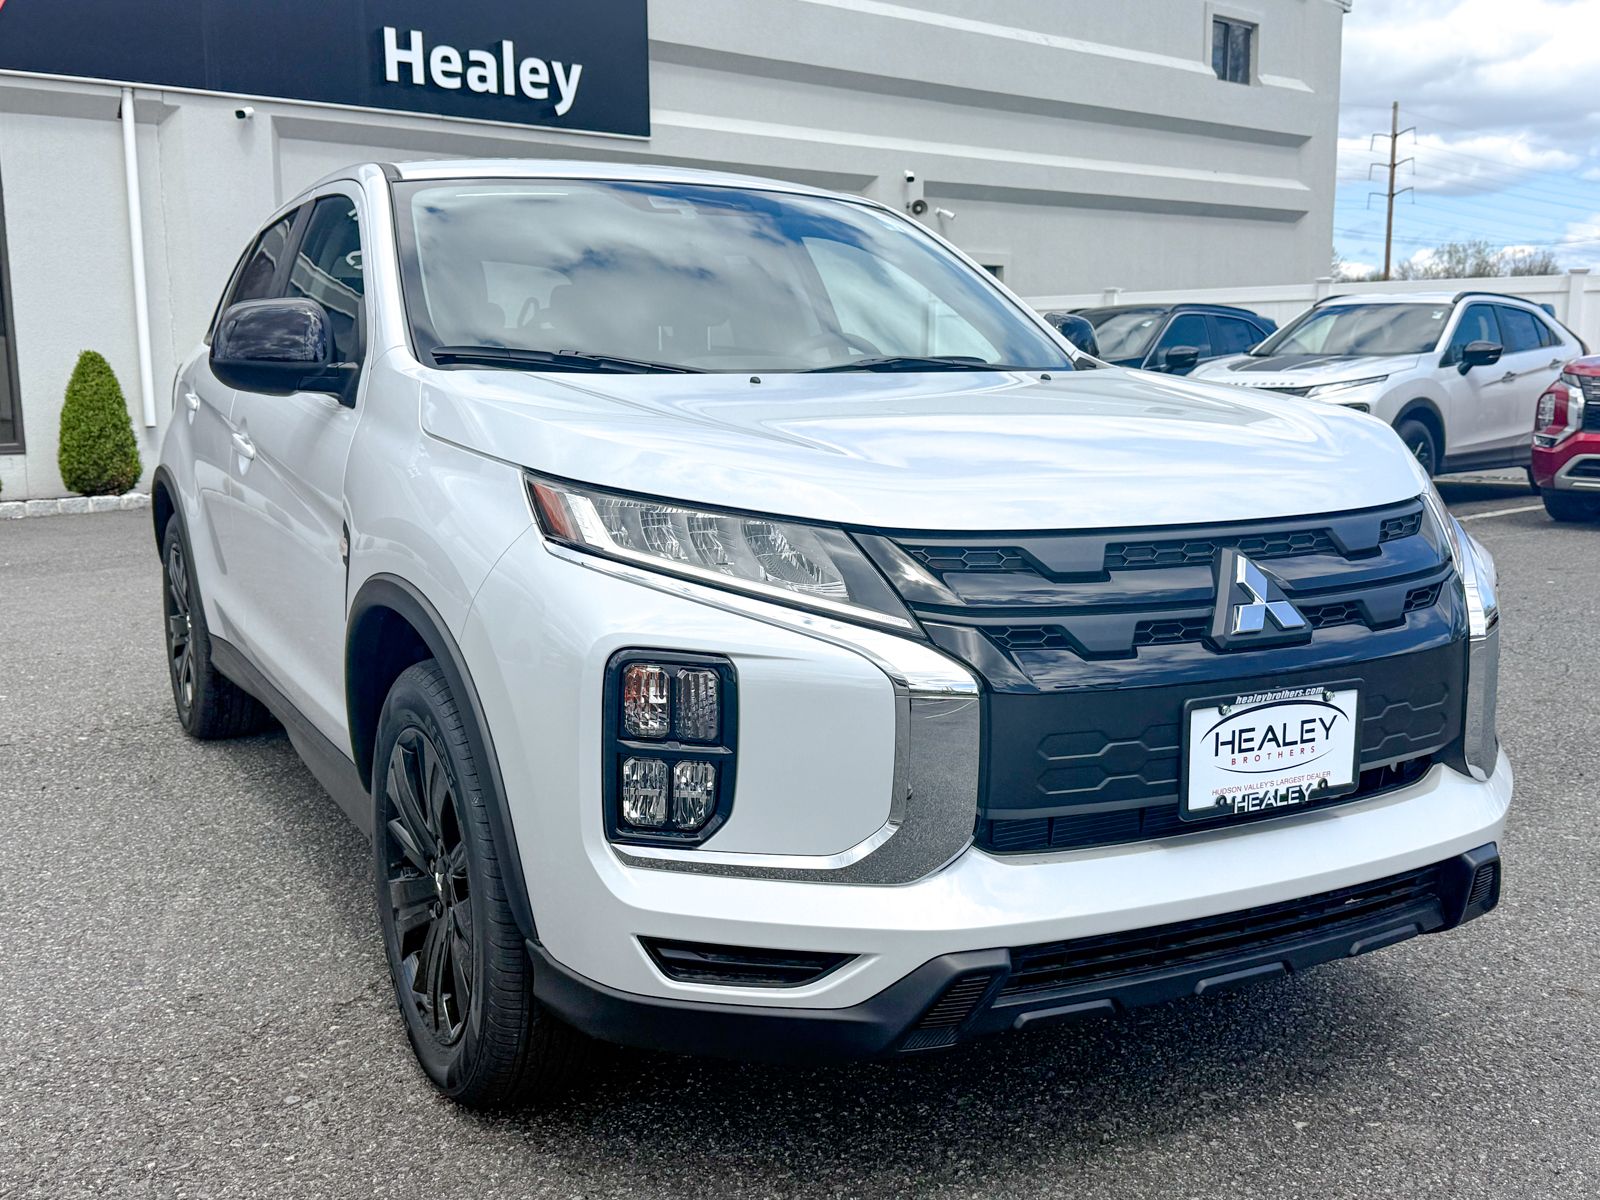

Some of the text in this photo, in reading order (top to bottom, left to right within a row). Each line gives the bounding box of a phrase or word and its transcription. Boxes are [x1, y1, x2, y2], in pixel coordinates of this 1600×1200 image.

[383, 26, 583, 117] Healey
[1235, 687, 1324, 704] healeybrothers.com
[1214, 715, 1338, 757] HEALEY
[1231, 746, 1315, 766] BROTHERS
[1212, 770, 1331, 796] HUDSON VALLEY'S LARGEST DEALER
[1234, 783, 1313, 813] HEALEY
